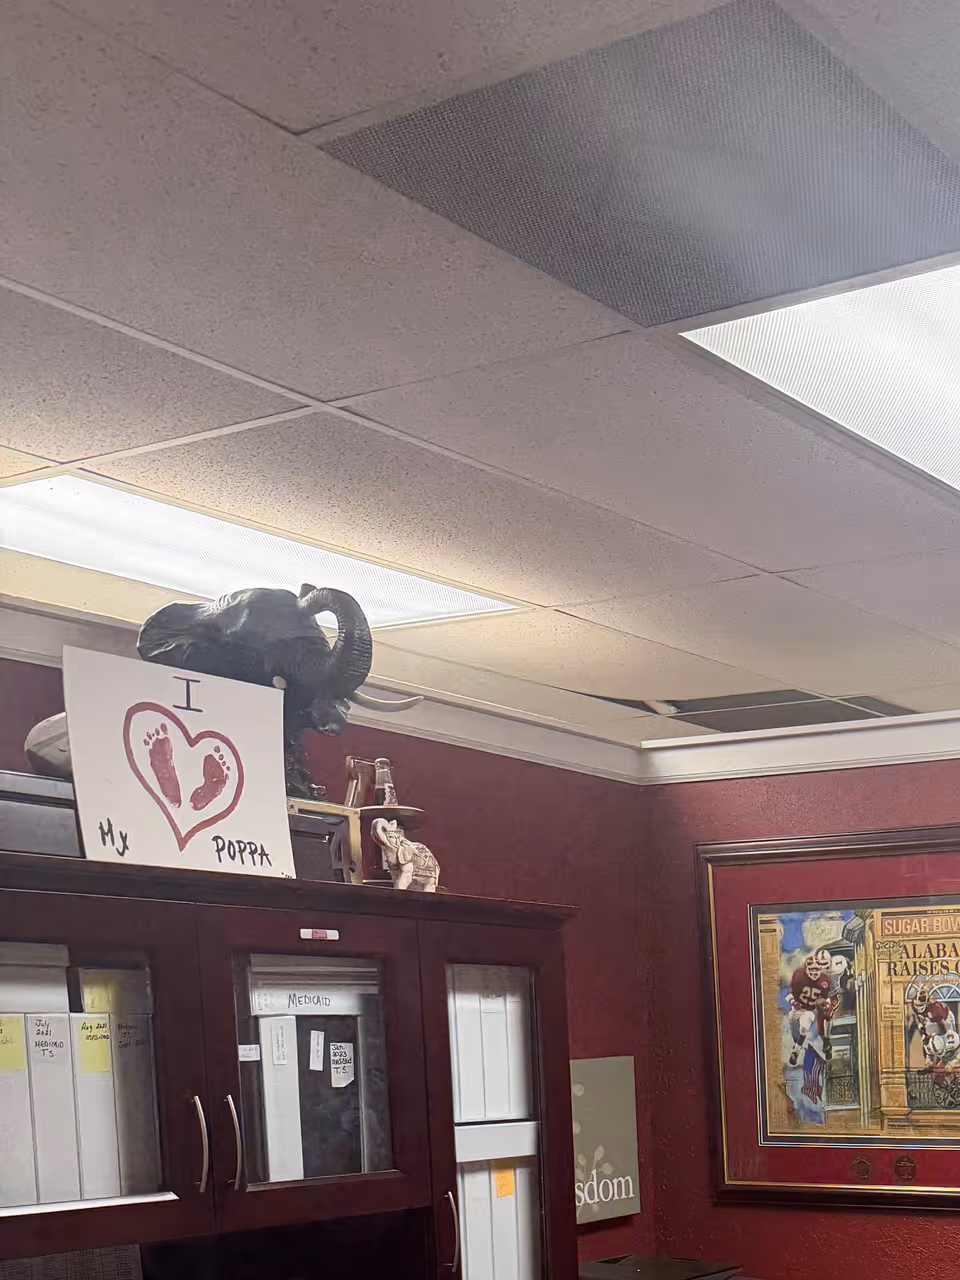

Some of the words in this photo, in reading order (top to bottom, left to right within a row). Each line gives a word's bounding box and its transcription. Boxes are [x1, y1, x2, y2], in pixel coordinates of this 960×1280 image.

[173, 676, 203, 712] I
[98, 817, 129, 857] My
[211, 835, 272, 867] POPPA
[884, 917, 930, 935] SUGAR
[887, 959, 950, 978] RAISES
[287, 992, 331, 1009] MEDICAID
[799, 985, 821, 1006] 25
[575, 1169, 635, 1205] sdom
